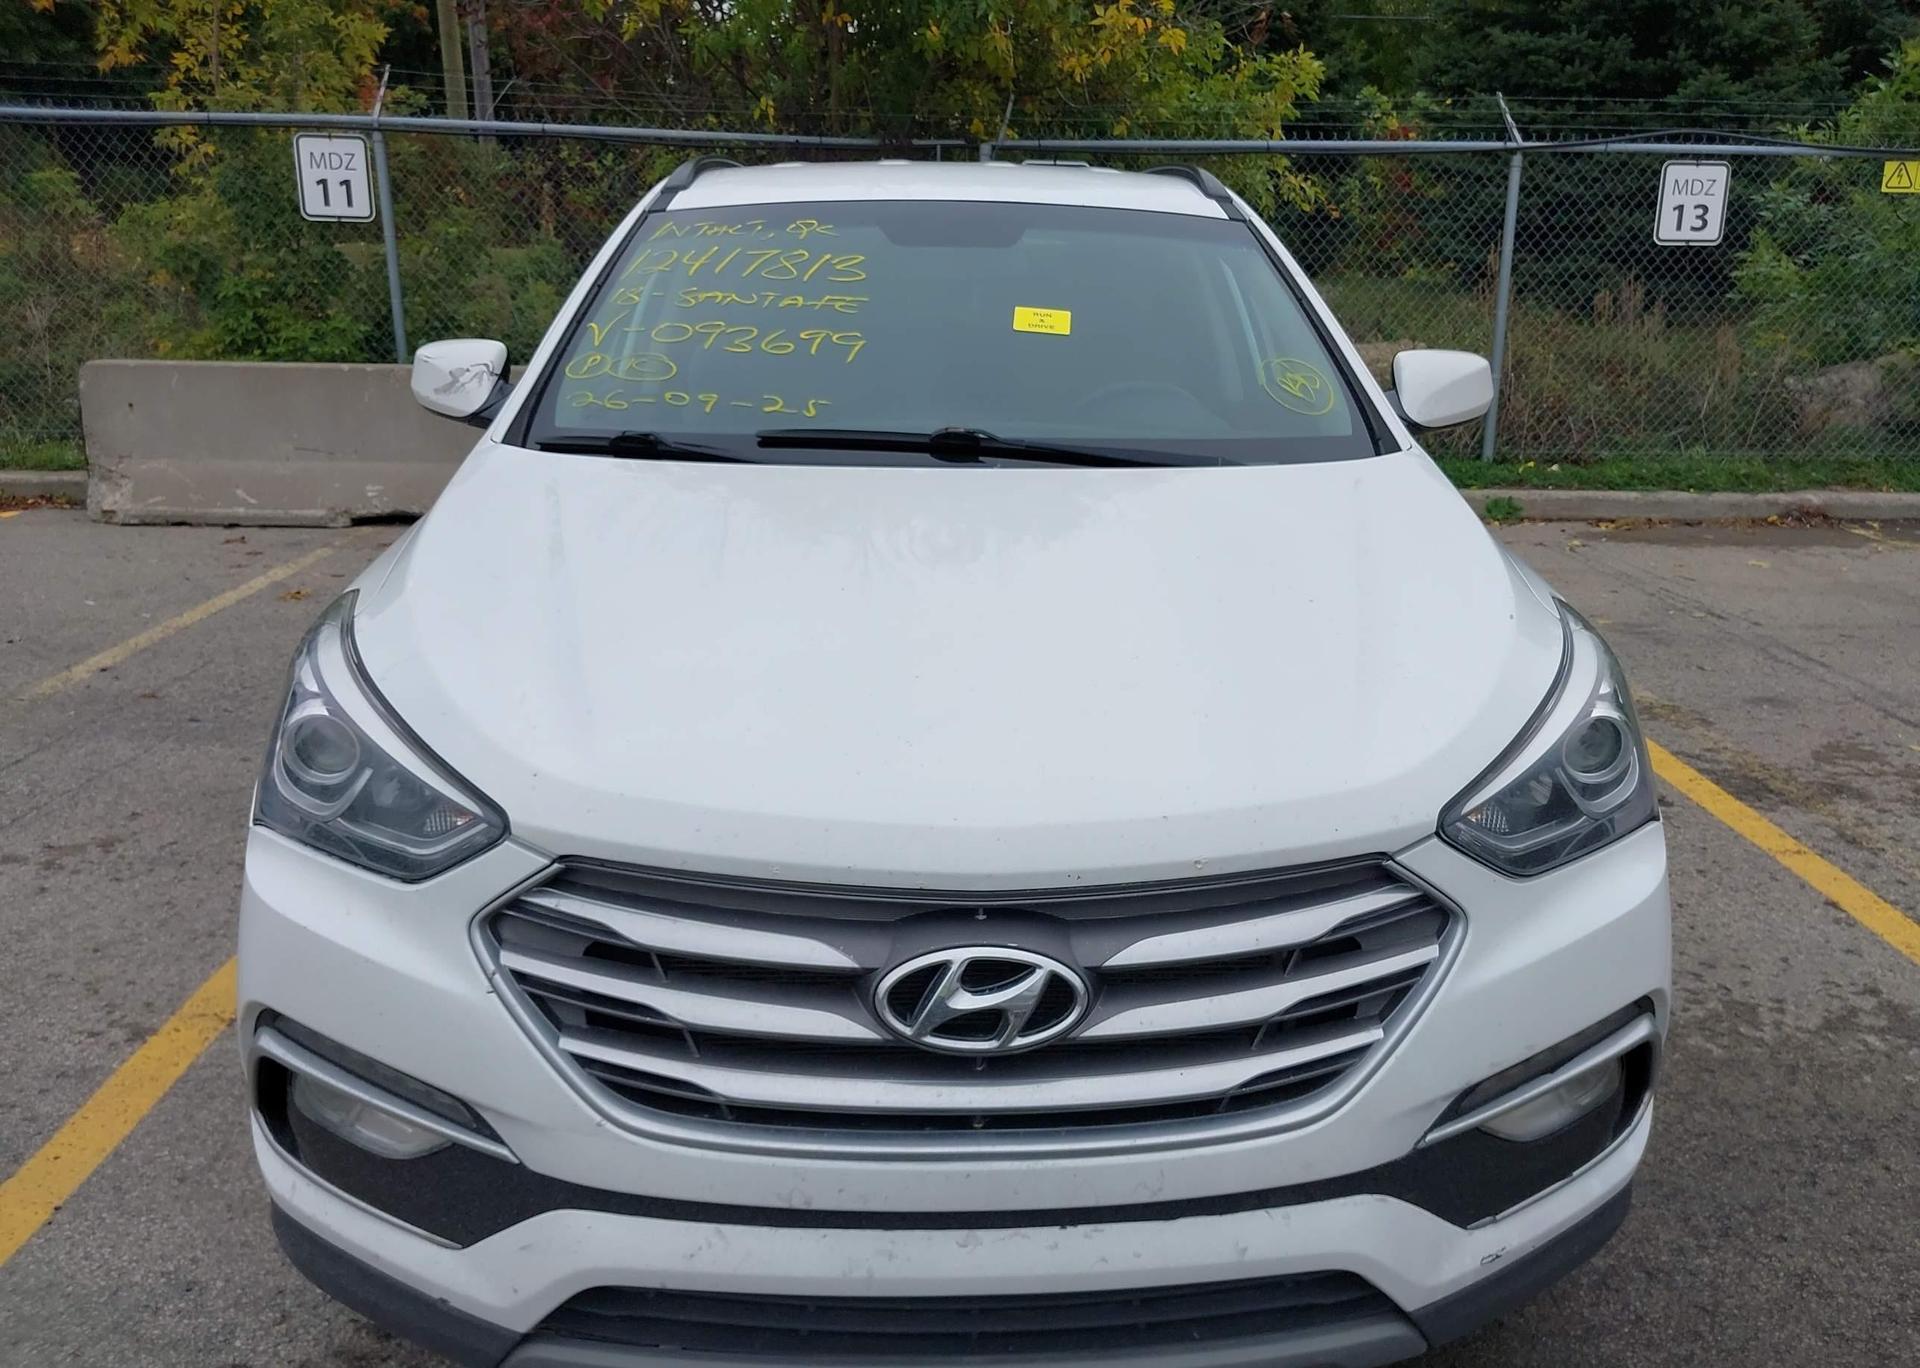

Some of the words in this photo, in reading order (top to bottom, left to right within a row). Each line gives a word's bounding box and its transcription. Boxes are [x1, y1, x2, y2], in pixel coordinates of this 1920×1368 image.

[309, 152, 357, 171] MDZ
[315, 178, 354, 208] 11
[1671, 179, 1718, 197] MDZ
[1672, 204, 1710, 232] 13
[621, 245, 867, 283] 12417813
